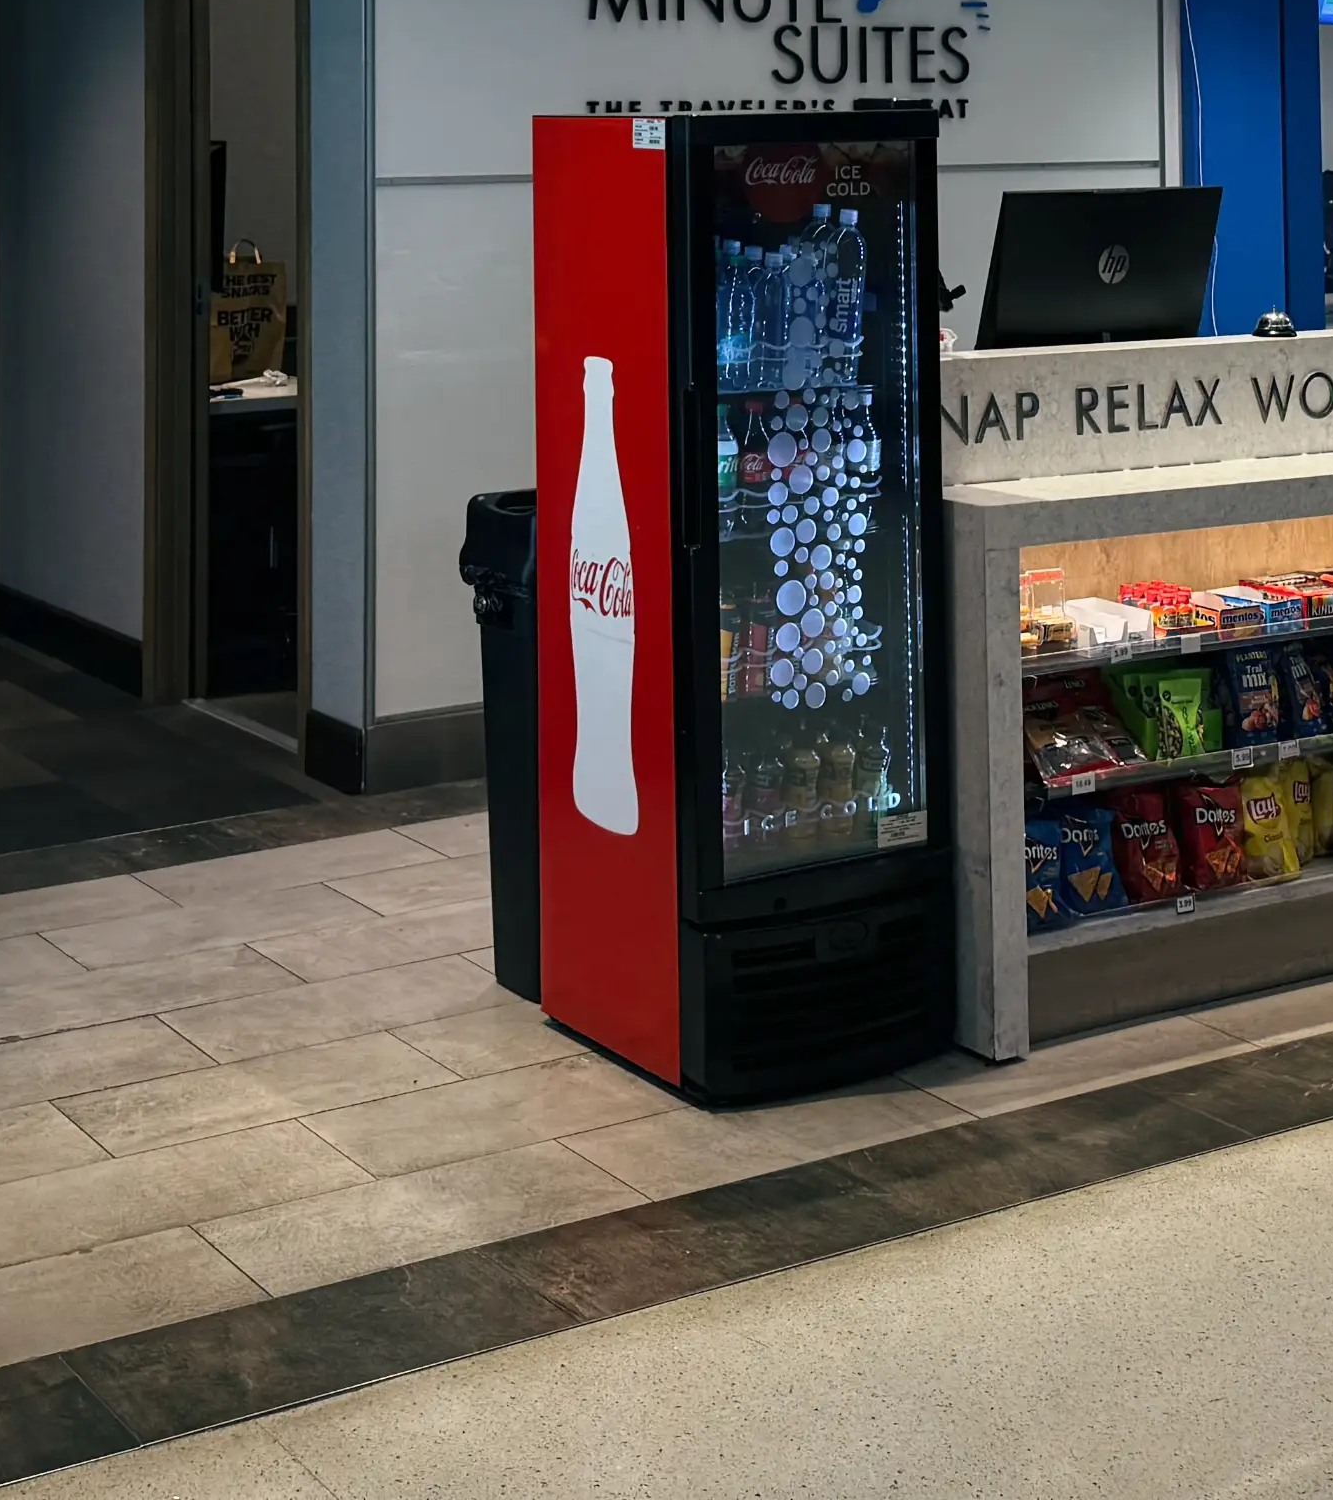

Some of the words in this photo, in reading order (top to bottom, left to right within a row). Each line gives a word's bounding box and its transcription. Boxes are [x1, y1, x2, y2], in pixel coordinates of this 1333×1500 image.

[771, 24, 971, 85] SUITES
[834, 165, 862, 181] ICE
[826, 182, 871, 197] COLD
[1101, 248, 1130, 284] hp
[834, 278, 852, 334] smart
[217, 307, 273, 327] BETTER
[1075, 378, 1224, 436] RELAX
[1222, 612, 1264, 624] mentos
[1311, 606, 1333, 616] KIND
[1242, 673, 1268, 688] mix
